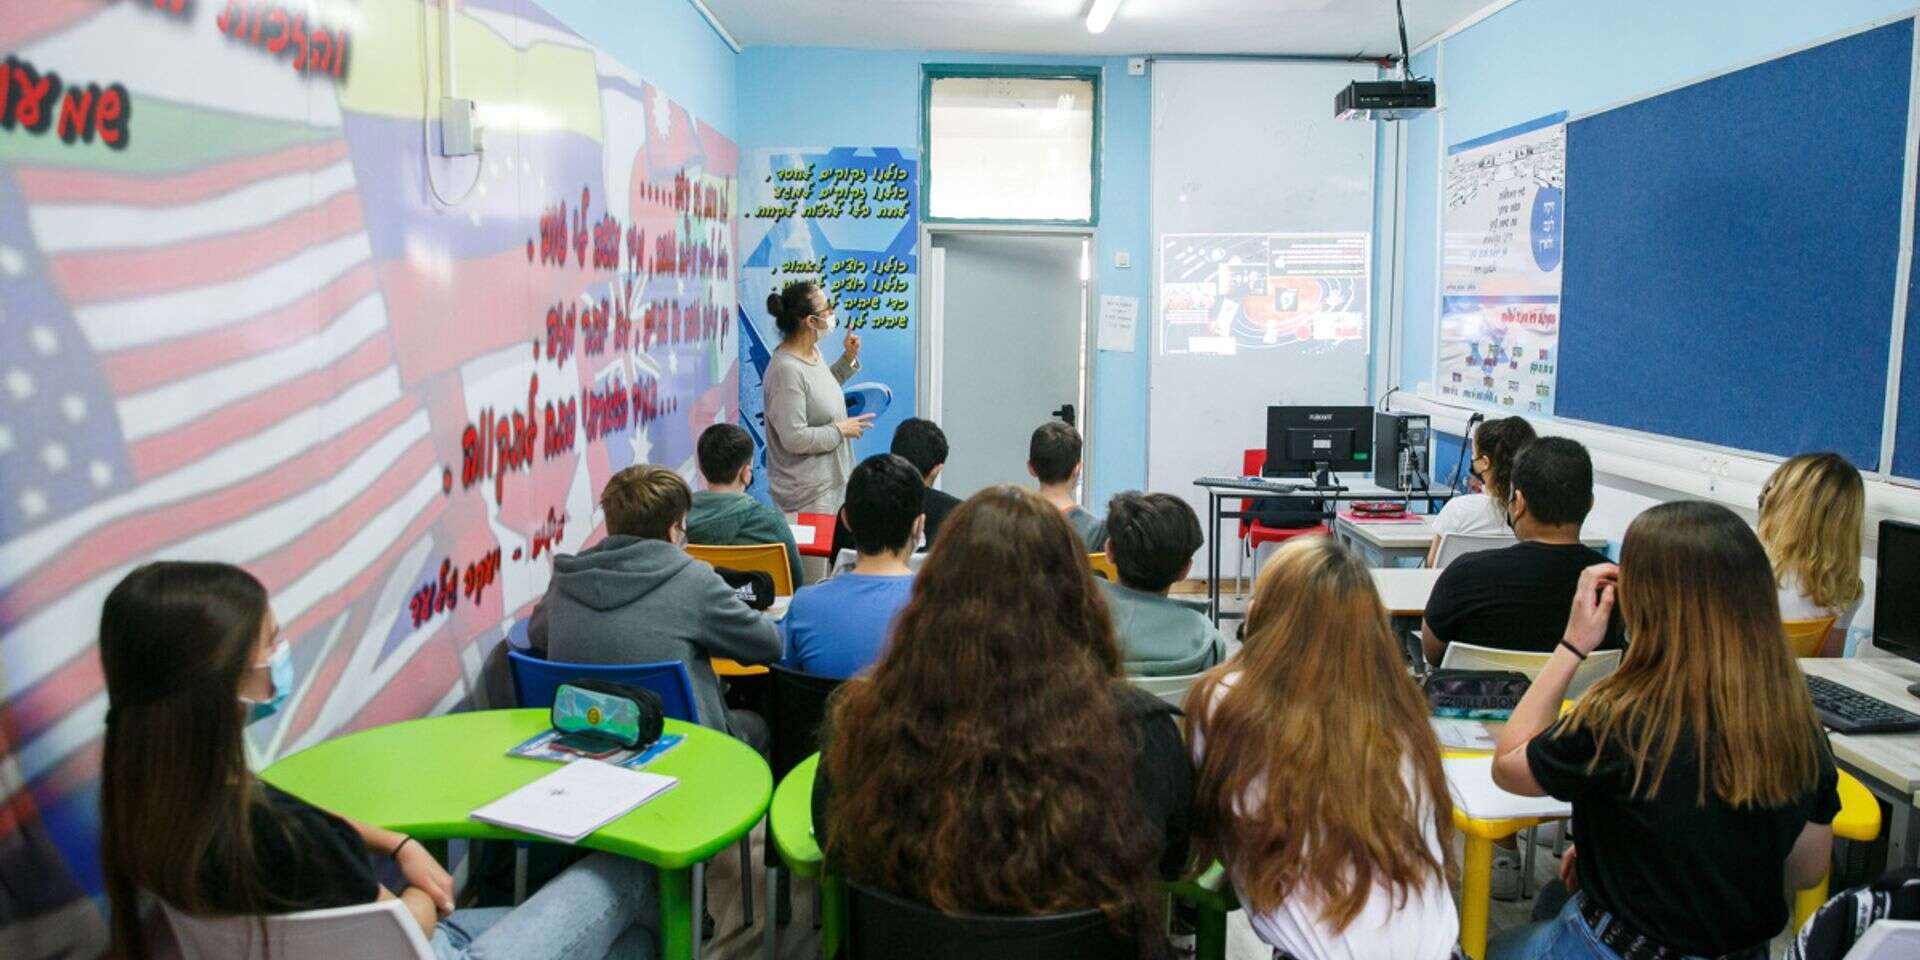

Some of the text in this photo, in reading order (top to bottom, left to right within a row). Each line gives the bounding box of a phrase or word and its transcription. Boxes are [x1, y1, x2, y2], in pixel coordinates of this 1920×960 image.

[819, 166, 867, 185] זקוקים
[872, 163, 907, 182] כולנו
[819, 186, 867, 204] זקוקים
[873, 182, 908, 202] כולנו
[831, 258, 866, 273] רוצים
[872, 255, 908, 274] כולנו
[831, 276, 866, 292] רוצים
[872, 274, 908, 291] כולנו
[844, 297, 880, 310] שיהיה
[872, 316, 908, 330] שיהיה
